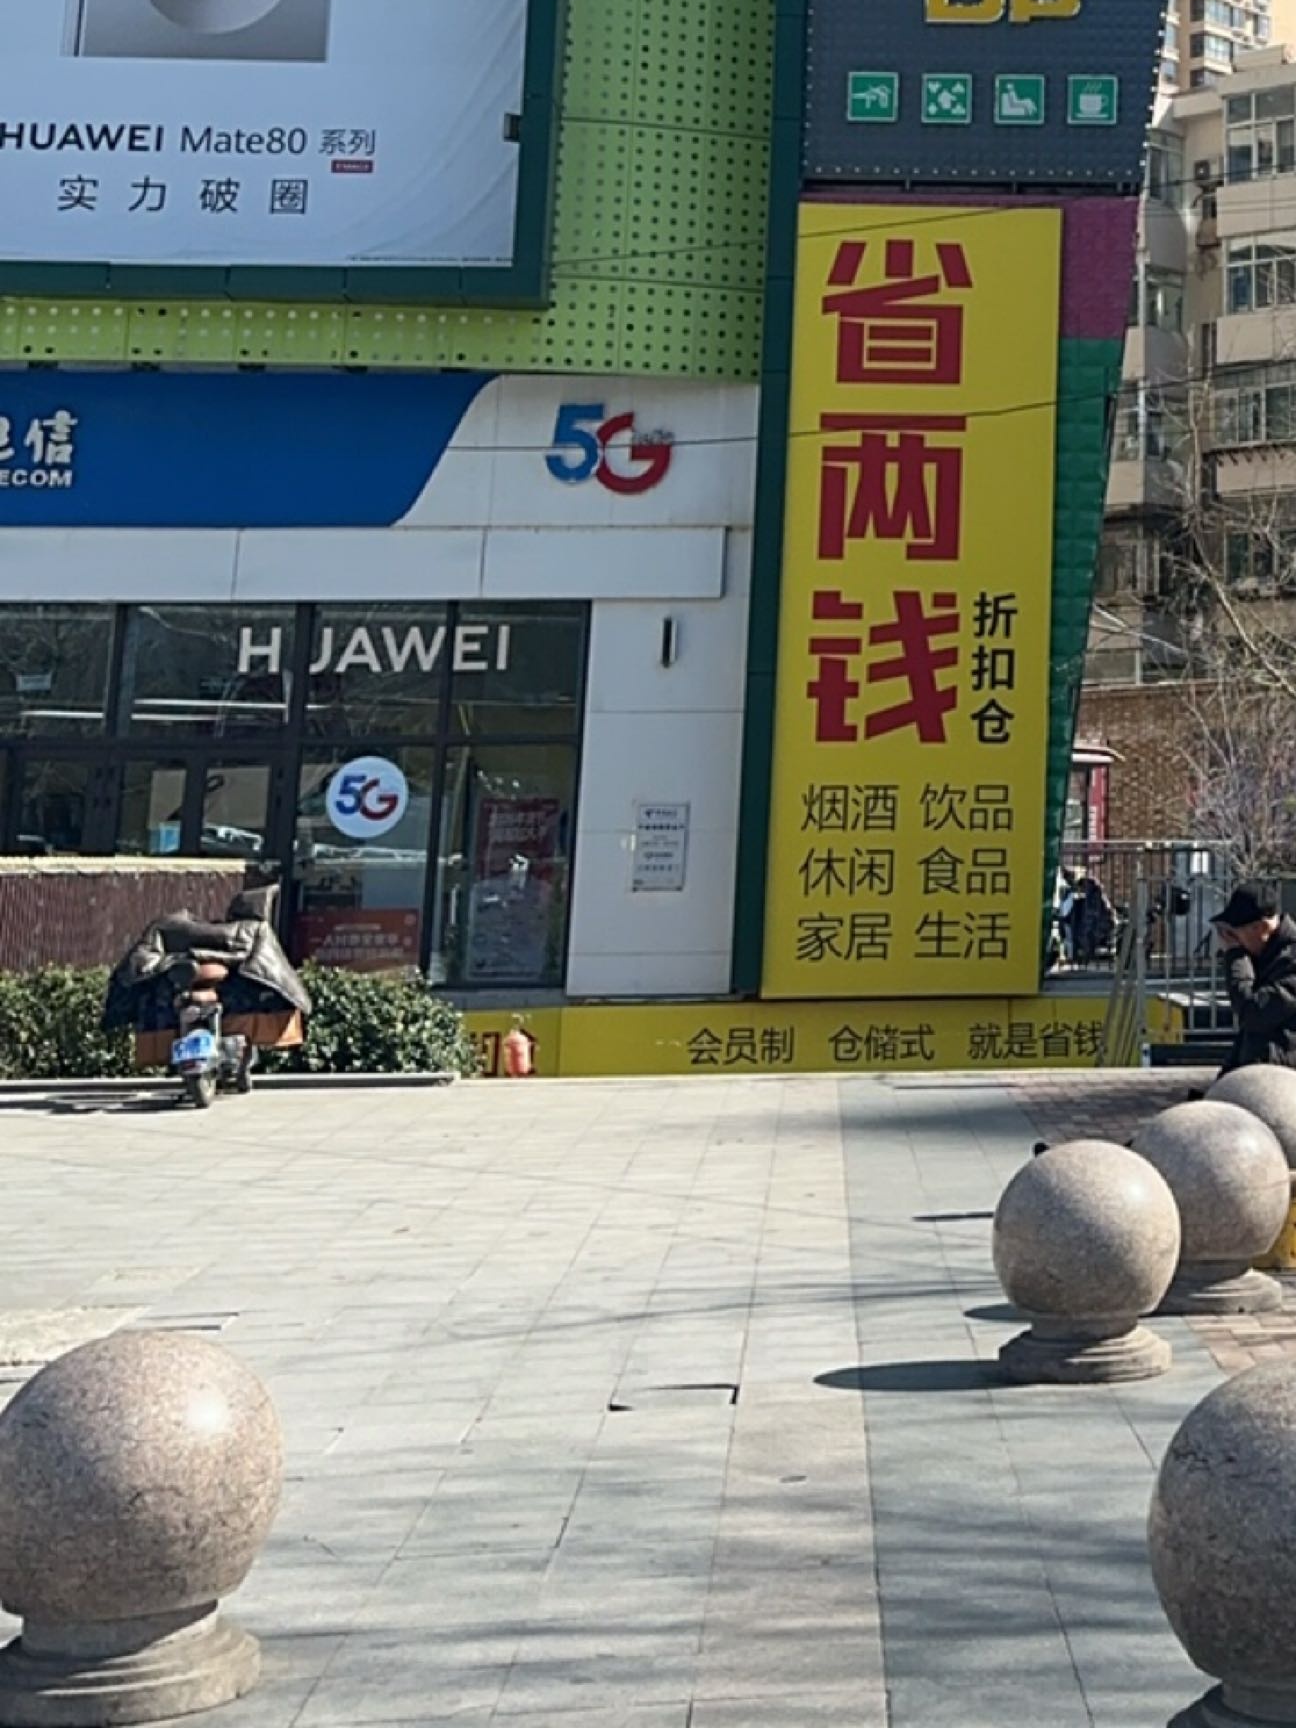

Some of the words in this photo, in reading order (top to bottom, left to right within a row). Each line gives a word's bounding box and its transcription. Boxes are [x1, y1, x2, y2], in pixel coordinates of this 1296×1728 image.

[0, 122, 164, 152] HUAWEI
[180, 126, 307, 155] Mate80
[317, 129, 376, 156] 系列
[58, 175, 308, 215] 实力破圈
[546, 403, 672, 494] 5G
[806, 239, 975, 744] 省两钱
[970, 591, 1018, 744] 折扣仓
[335, 775, 399, 821] 5G
[801, 783, 899, 832] 烟酒
[919, 782, 1013, 832] 饮品
[799, 847, 895, 897] 休闲
[917, 845, 1010, 895] 食品
[796, 912, 893, 962] 家居
[914, 909, 1011, 960] 生活
[686, 1026, 794, 1065] 会员制
[828, 1024, 936, 1062] 仓储式
[968, 1021, 1108, 1061] 就是省钱
